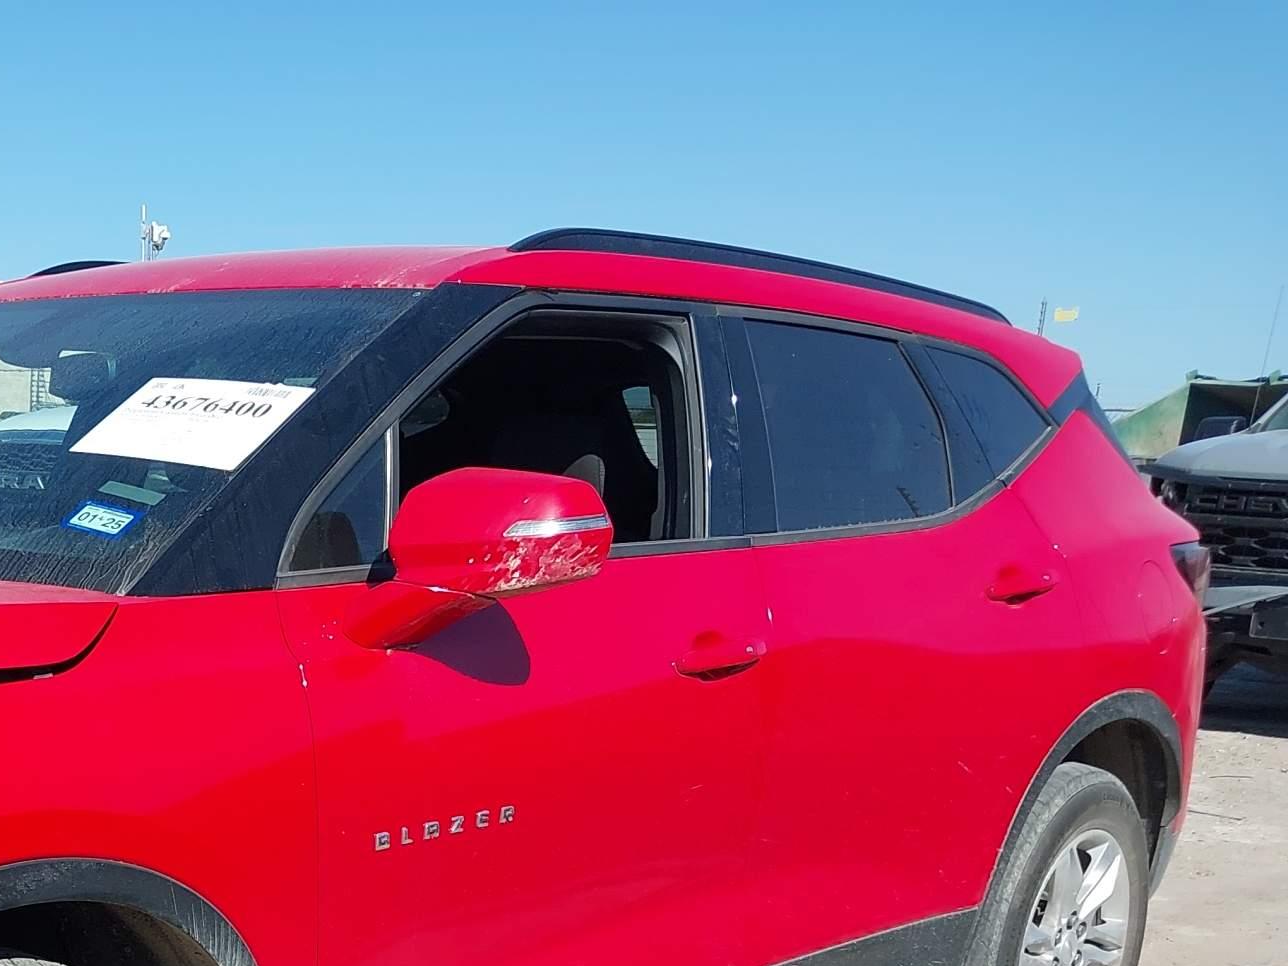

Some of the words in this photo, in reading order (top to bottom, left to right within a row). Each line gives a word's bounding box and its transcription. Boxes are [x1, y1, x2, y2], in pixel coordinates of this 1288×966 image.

[141, 395, 273, 418] 43676400
[100, 517, 126, 530] 25
[373, 805, 515, 851] BLAZER
